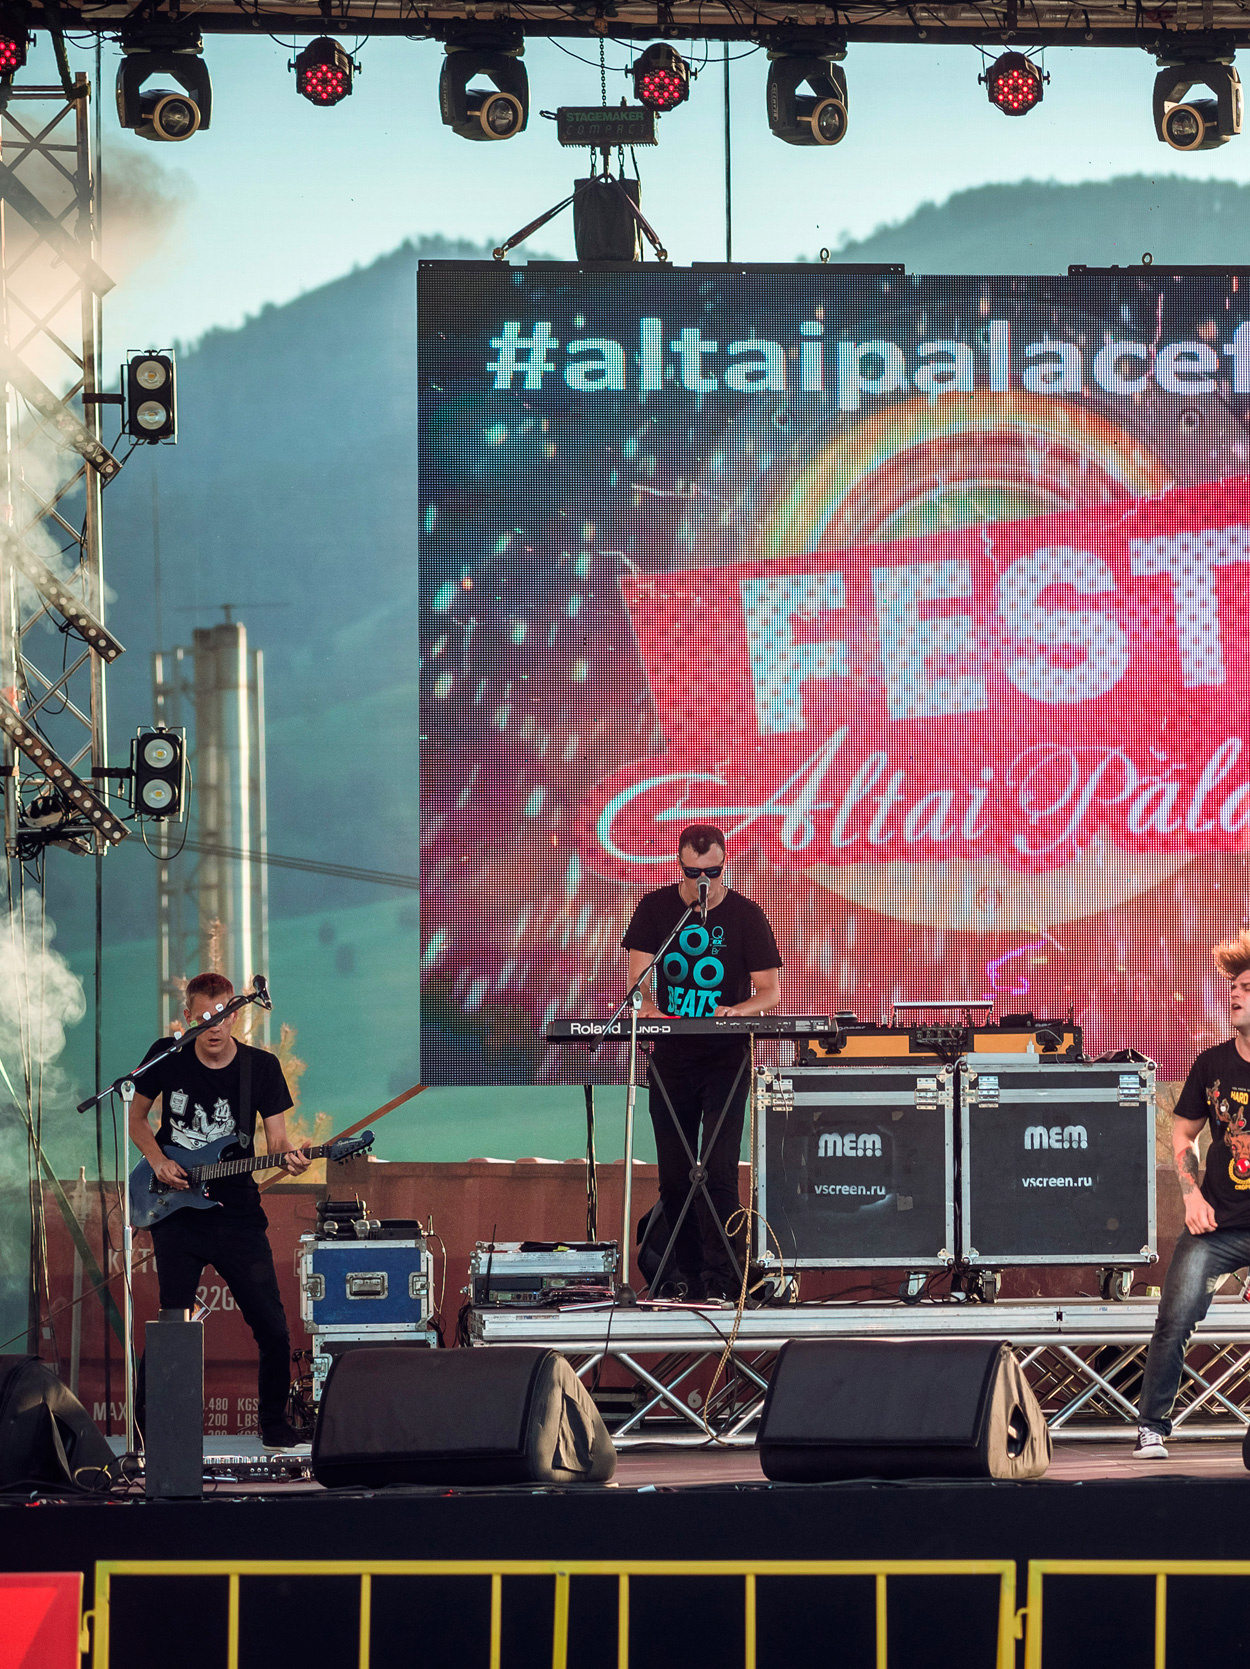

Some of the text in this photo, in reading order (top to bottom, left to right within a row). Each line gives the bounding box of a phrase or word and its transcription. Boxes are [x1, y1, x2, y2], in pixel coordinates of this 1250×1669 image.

[566, 111, 644, 122] STAGEMAKER
[566, 124, 646, 135] COMPACT
[596, 725, 997, 863] Altai
[667, 985, 722, 1017] BEATS
[1230, 1090, 1249, 1106] HARD
[1021, 1175, 1093, 1188] vscreen.ru
[814, 1183, 886, 1196] vscreen.ru
[197, 1285, 241, 1311] 22G
[203, 1397, 259, 1411] .480 KGS
[93, 1402, 128, 1421] MAX
[203, 1413, 259, 1427] .200 LBS
